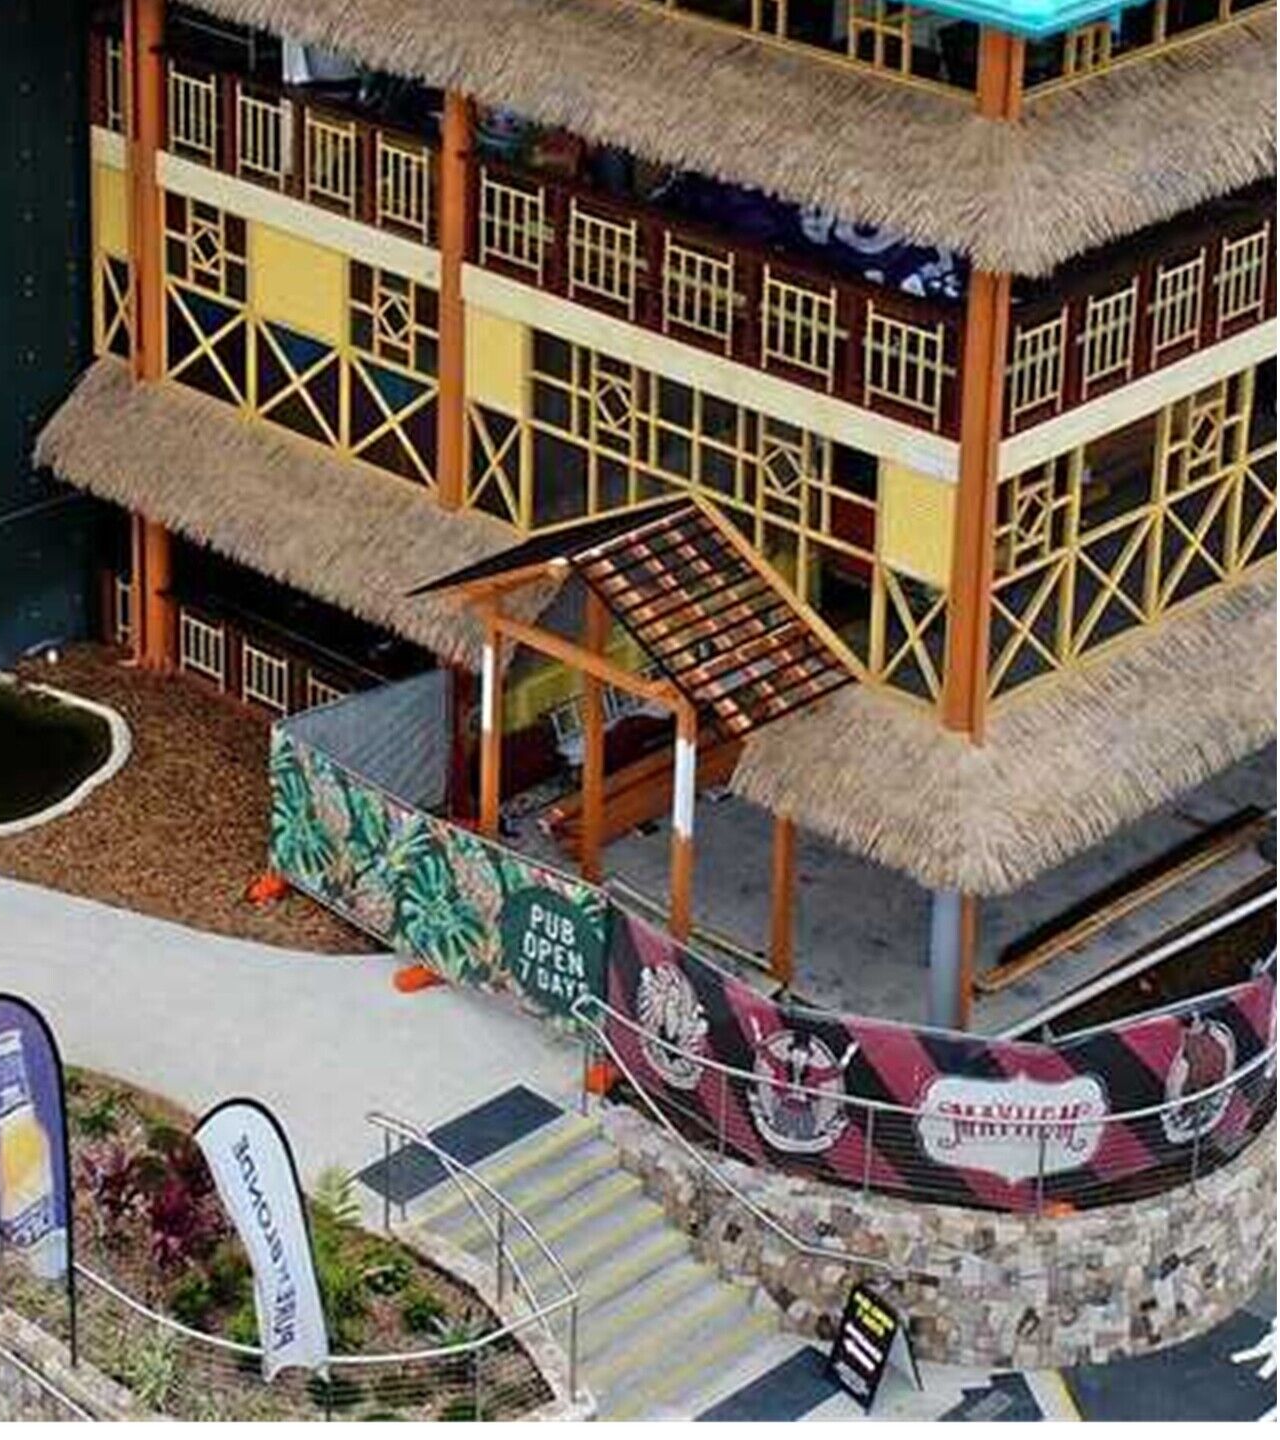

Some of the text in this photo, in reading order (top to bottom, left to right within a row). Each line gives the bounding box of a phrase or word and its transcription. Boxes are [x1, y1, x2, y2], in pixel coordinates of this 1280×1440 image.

[530, 903, 575, 946] PUB
[519, 958, 531, 981] 7
[522, 930, 585, 979] OPEN
